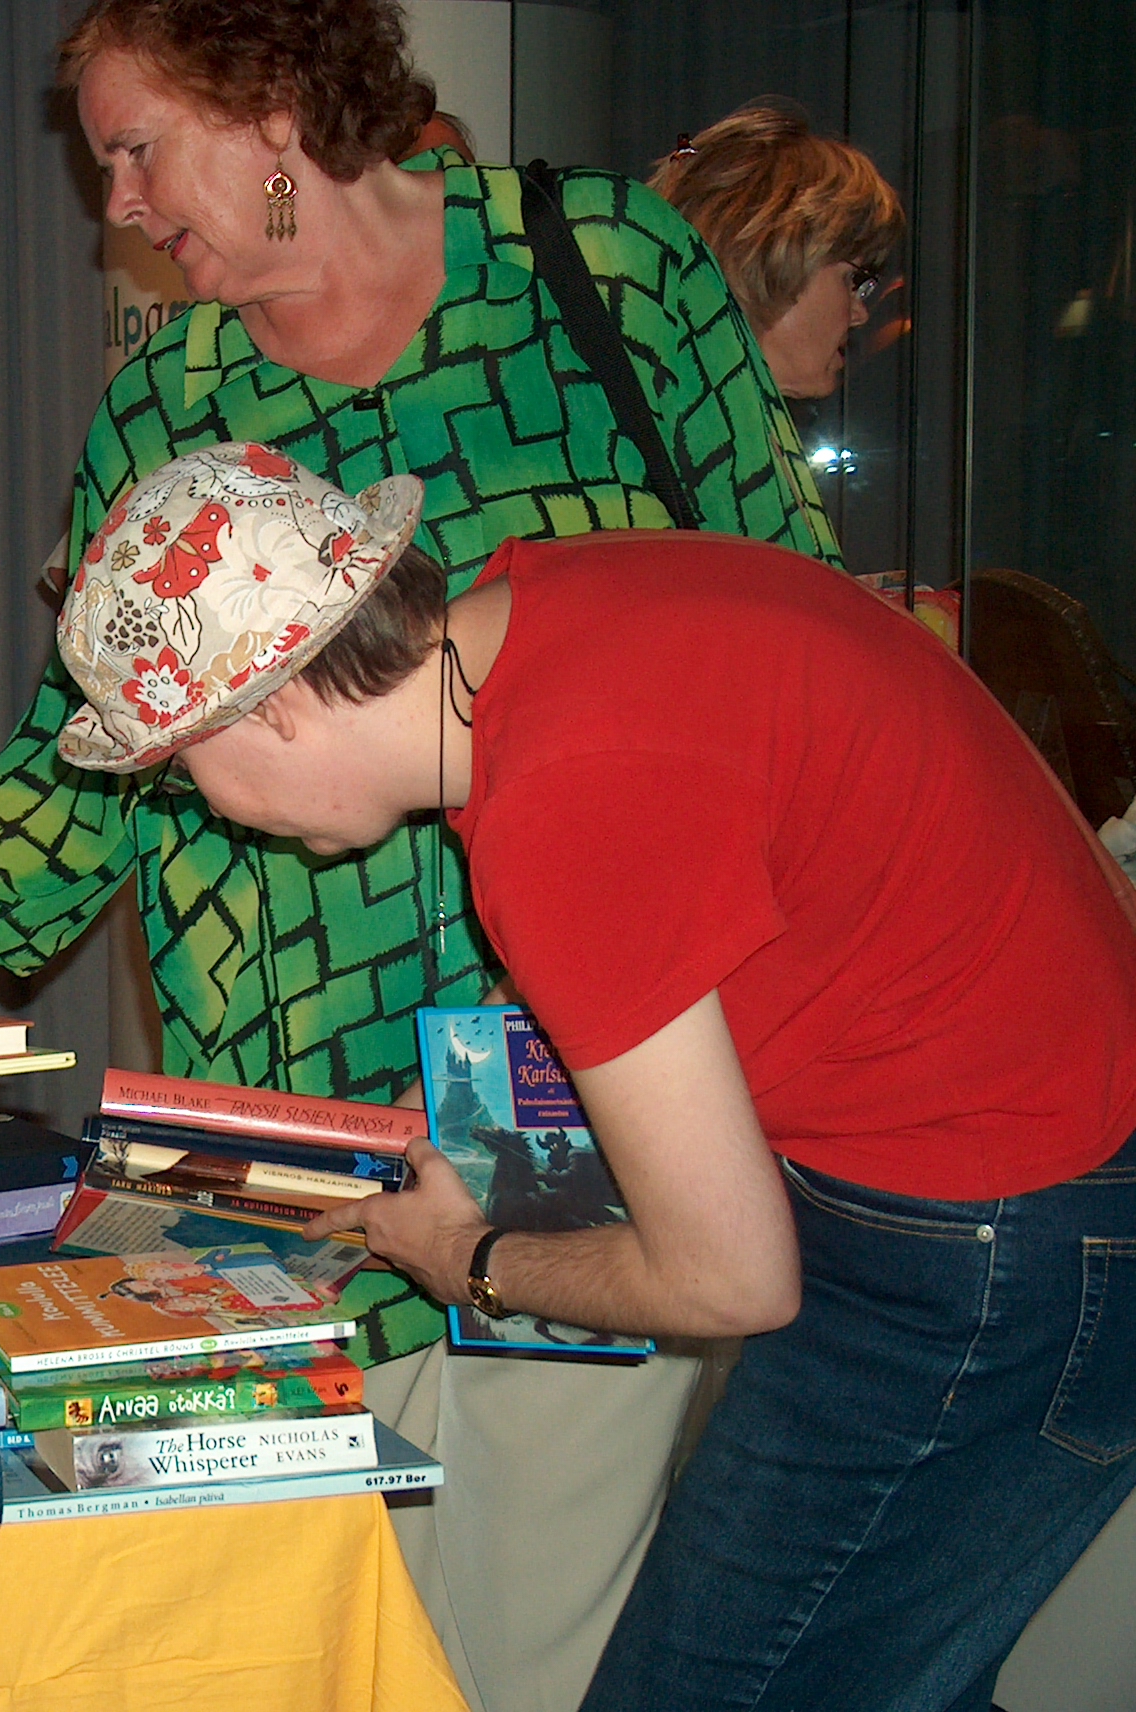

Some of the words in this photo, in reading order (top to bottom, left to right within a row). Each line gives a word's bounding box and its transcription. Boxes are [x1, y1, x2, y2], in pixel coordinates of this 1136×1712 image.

[119, 1086, 169, 1101] MICHAEL
[173, 1093, 212, 1109] BLAKE
[216, 1097, 280, 1119] TANSSII
[282, 1106, 336, 1128] SUSIEN
[340, 1111, 394, 1134] KANSSA
[37, 1355, 74, 1367] HELENA
[77, 1352, 104, 1362] BROSS
[116, 1346, 160, 1358] CHRISTEL
[98, 1395, 159, 1423] Arvaa
[156, 1438, 184, 1454] The
[187, 1433, 246, 1452] Horse
[259, 1428, 339, 1446] NICHOLAS
[148, 1453, 258, 1476] Whisperer
[276, 1448, 326, 1463] EVANS
[365, 1475, 402, 1486] 617.97
[406, 1474, 426, 1483] Ber
[17, 1506, 72, 1519] Thomas
[77, 1500, 139, 1514] Bergman
[155, 1494, 196, 1506] Isabellan
[198, 1492, 224, 1506] päivä
